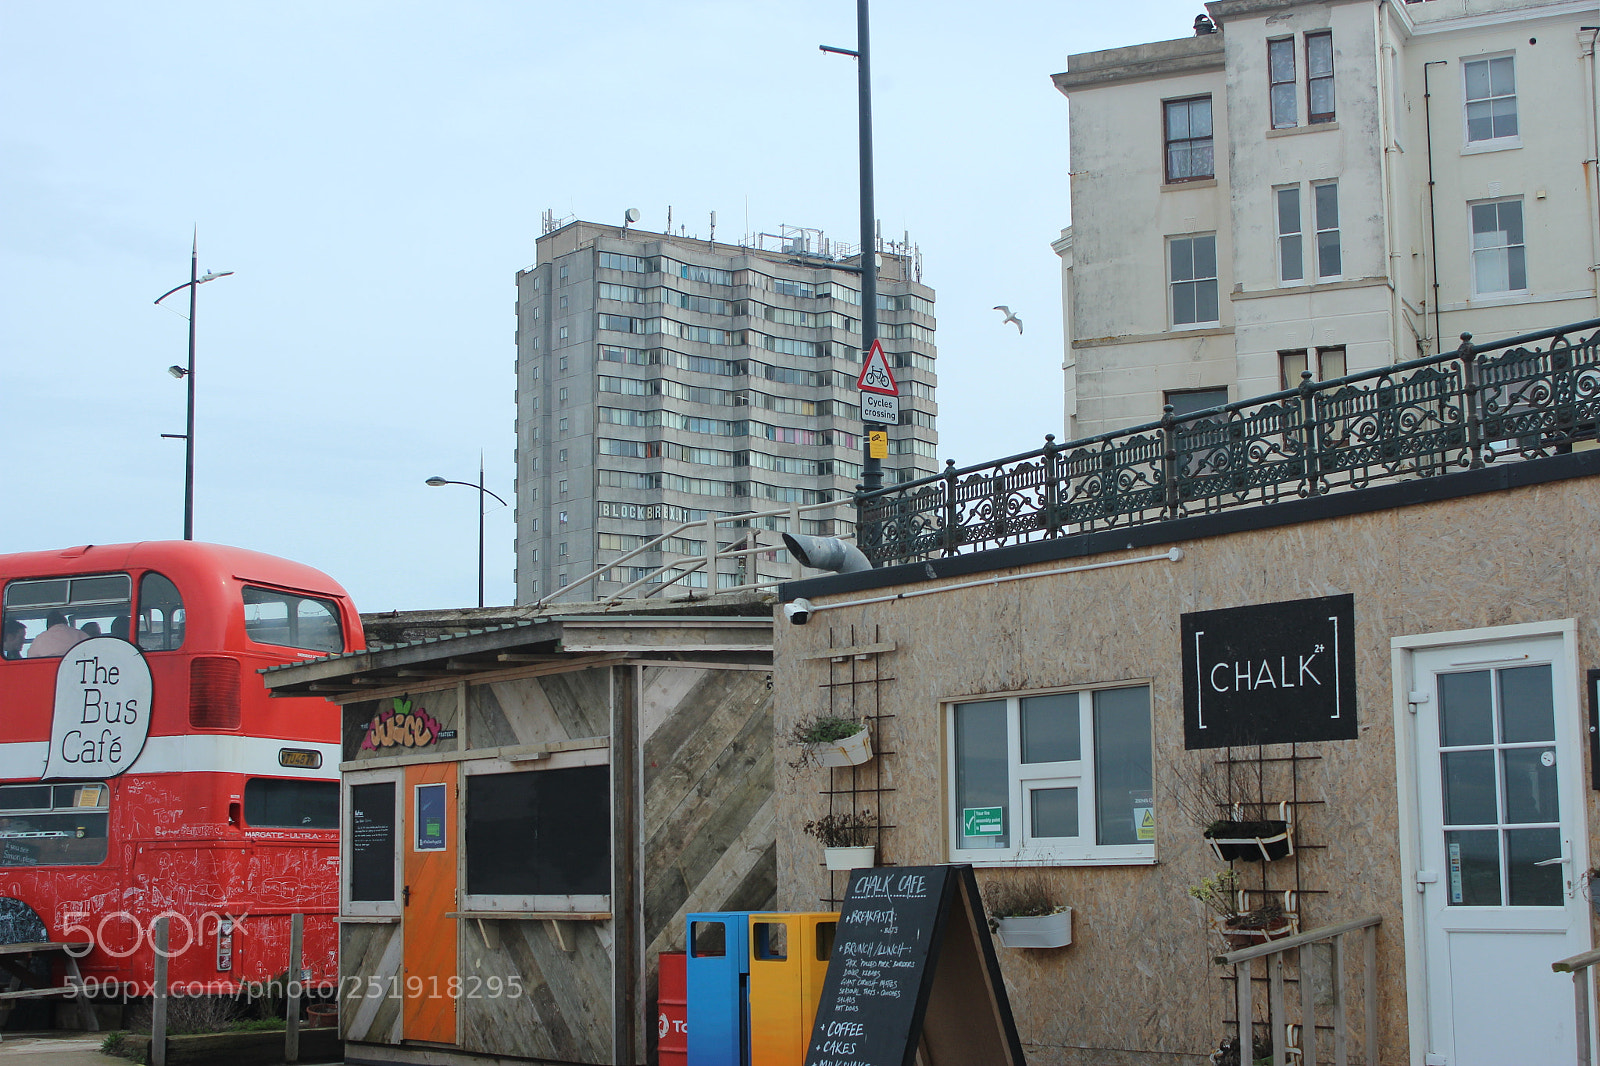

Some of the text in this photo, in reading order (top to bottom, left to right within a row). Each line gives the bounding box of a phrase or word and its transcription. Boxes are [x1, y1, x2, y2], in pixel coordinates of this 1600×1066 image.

[867, 396, 893, 408] Cycles
[864, 409, 896, 421] crossing
[603, 503, 645, 520] BLOCK
[75, 656, 120, 685] The
[1210, 653, 1322, 693] CHALK
[80, 688, 138, 725] Bus
[61, 728, 122, 764] Café
[854, 874, 927, 898] CHALK CAFE
[836, 996, 856, 1004] SALADS
[827, 1020, 864, 1037] COFFEE
[823, 1040, 857, 1056] CAKES
